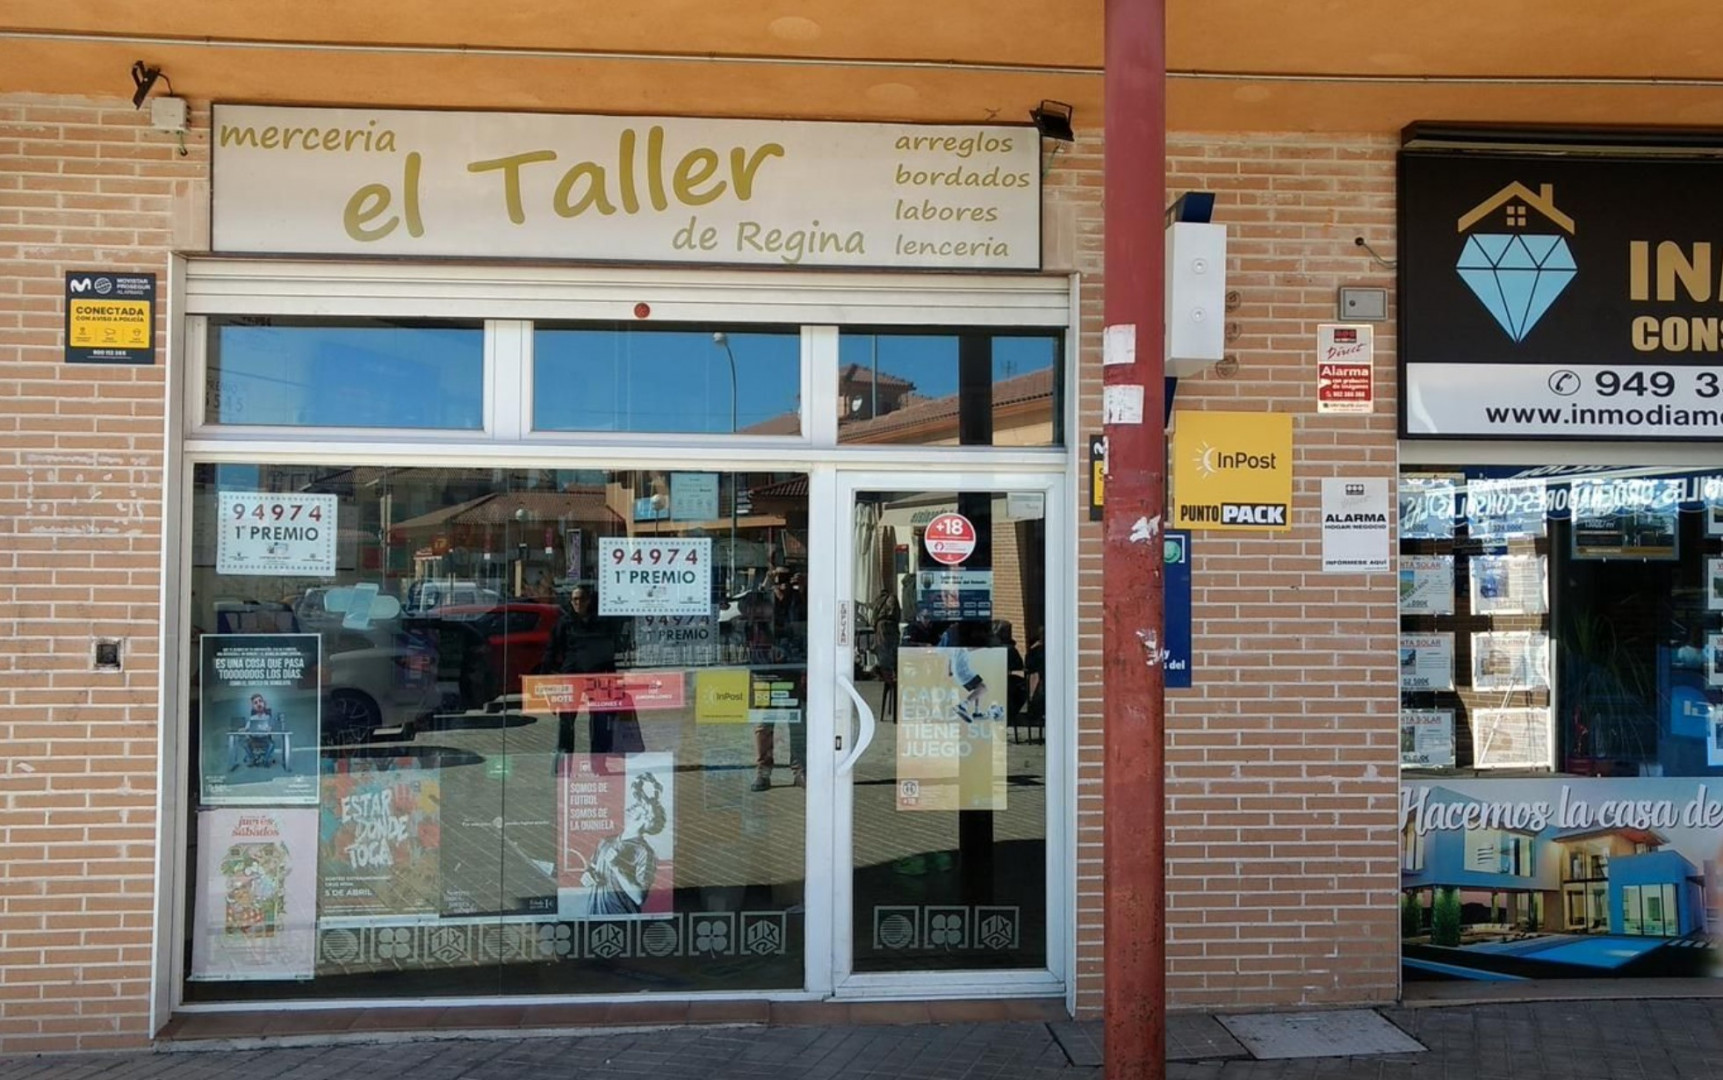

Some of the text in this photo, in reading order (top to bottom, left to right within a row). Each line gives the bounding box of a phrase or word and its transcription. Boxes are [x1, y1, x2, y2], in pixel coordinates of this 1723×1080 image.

[219, 120, 397, 153] merceria
[895, 131, 1013, 157] arreglos
[343, 125, 785, 242] el Taller
[896, 164, 1031, 188] bordados
[896, 200, 998, 222] labores
[672, 216, 866, 265] de Regina
[896, 234, 1010, 258] lenceria
[1630, 240, 1723, 302] IN
[75, 306, 145, 316] CONECTADA
[1632, 316, 1723, 351] CON
[1321, 366, 1369, 376] Alarma
[1595, 370, 1723, 398] 949 3
[1486, 402, 1723, 426] www.inmodiam
[1218, 452, 1276, 469] InPost
[232, 503, 322, 522] 94974
[1181, 505, 1284, 523] PUNTO PACK
[1325, 513, 1387, 523] ALARMA
[250, 526, 319, 541] PREMIO
[936, 519, 963, 535] +18
[612, 548, 698, 565] 94974
[629, 570, 696, 584] PREMIO
[658, 628, 709, 641] PREMIO
[215, 658, 304, 669] ES UNA COSA QUE PASA
[1169, 661, 1185, 669] del
[266, 669, 281, 680] LOS
[716, 692, 743, 701] InPost
[902, 724, 994, 740] TIENE SU
[903, 742, 972, 758] JUEGO
[570, 782, 608, 793] SOMOS DE
[341, 789, 392, 822] ESTAR
[570, 807, 608, 818] SOMOS DE
[1397, 784, 1723, 836] Hacemos la casa de
[355, 814, 408, 843] DONDE
[570, 819, 580, 830] LA
[344, 839, 393, 869] TOCA
[346, 888, 372, 896] ABRIL
